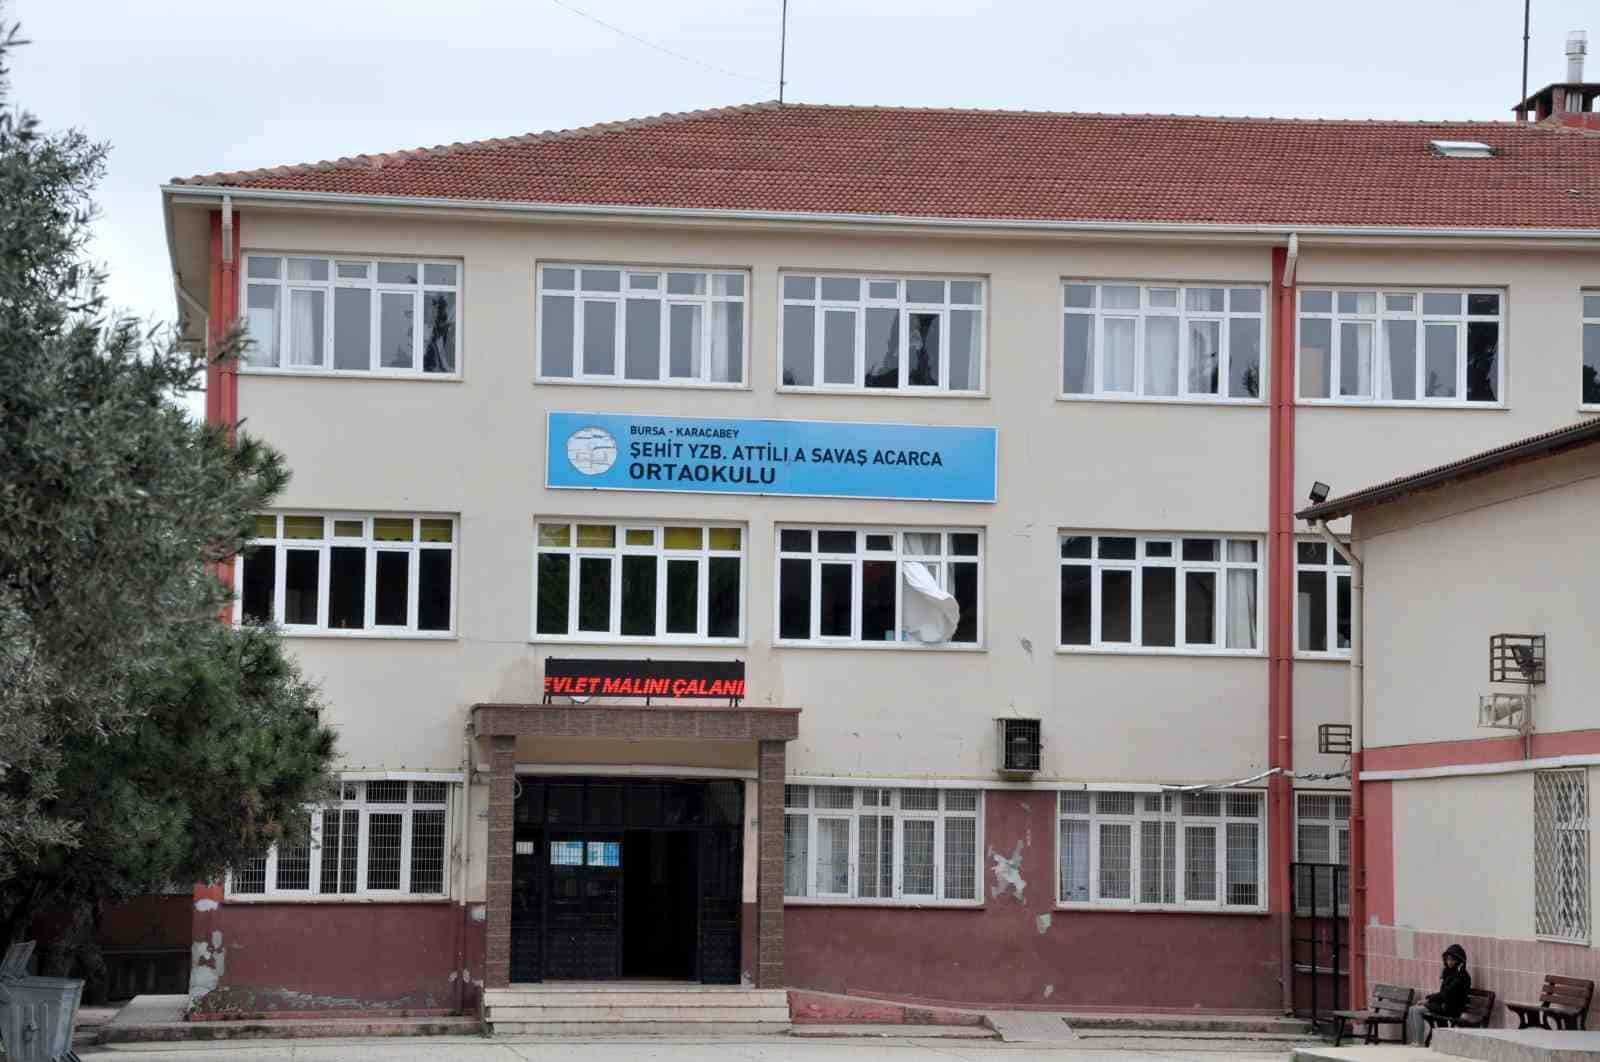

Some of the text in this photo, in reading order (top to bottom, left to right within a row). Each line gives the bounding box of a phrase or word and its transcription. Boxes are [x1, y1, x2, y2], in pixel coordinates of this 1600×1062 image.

[630, 425, 665, 437] BURSA
[676, 427, 740, 439] KARACABEY
[630, 439, 683, 460] ŞEHİT
[687, 443, 730, 461] YZB.
[812, 448, 868, 467] SAVAŞ
[872, 449, 944, 467] ACARCA
[629, 463, 776, 485] ORTAOKULU
[603, 678, 669, 696] MALINI
[672, 680, 745, 699] ÇALANI
